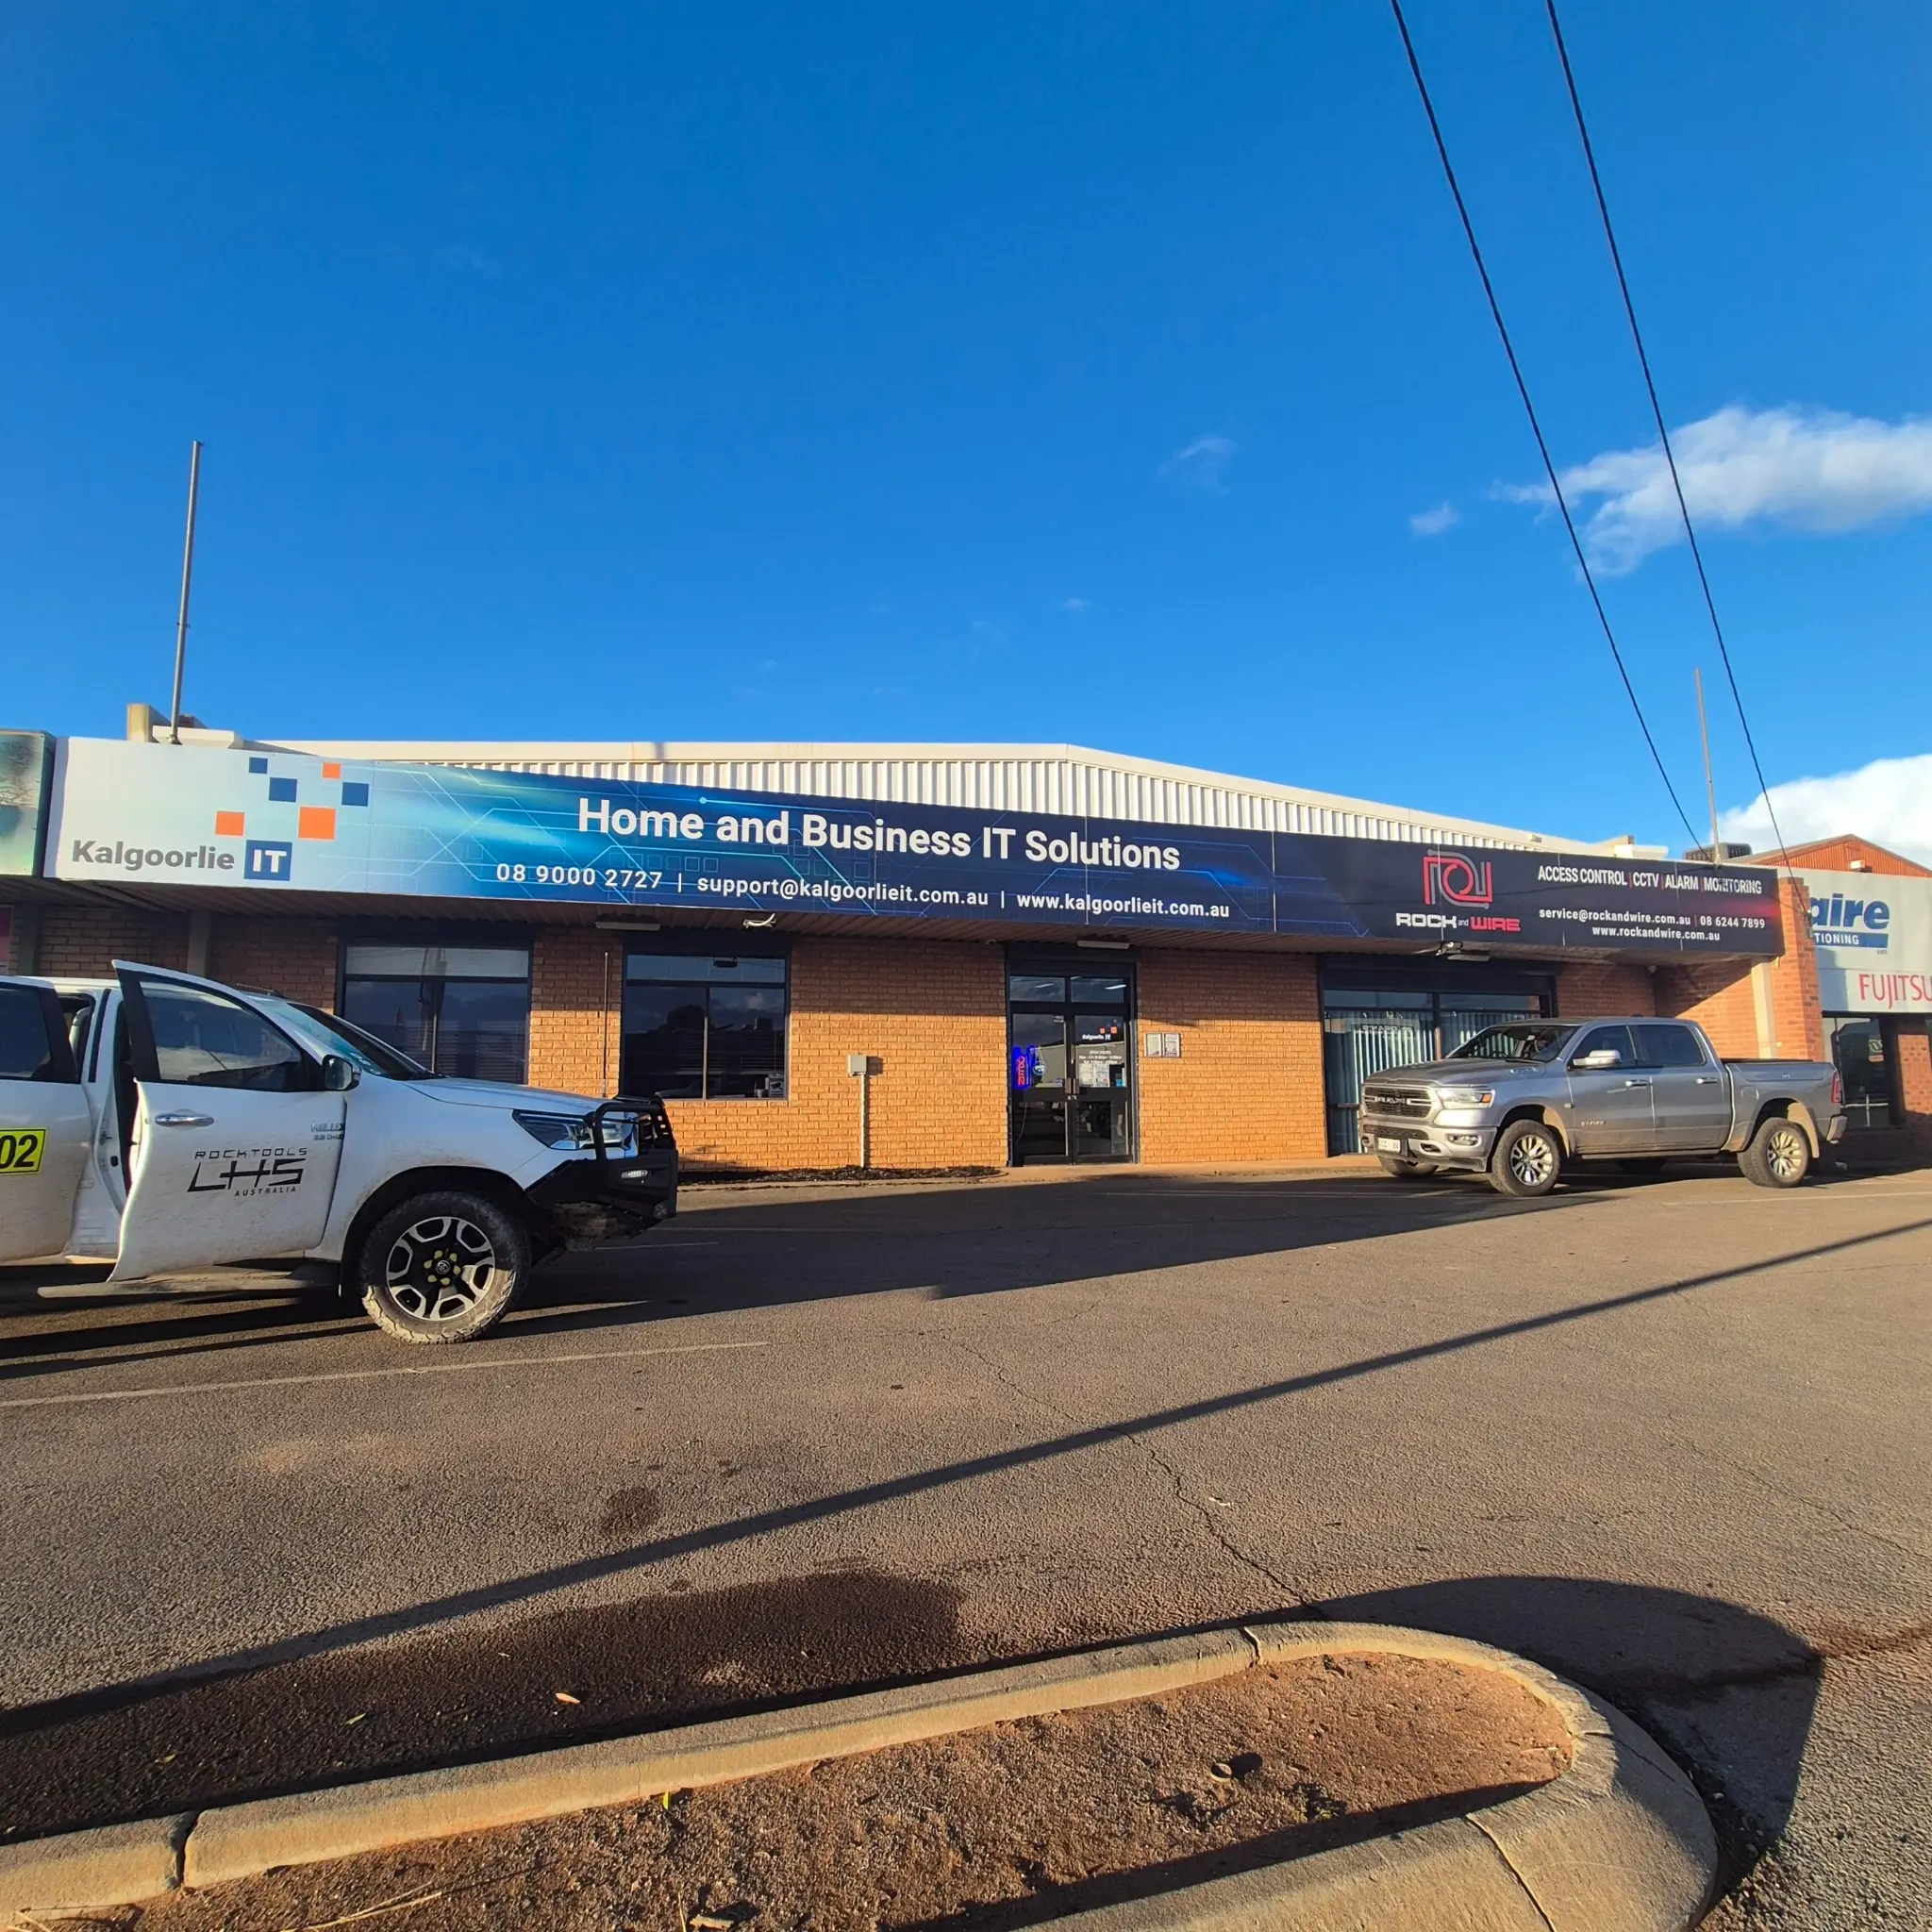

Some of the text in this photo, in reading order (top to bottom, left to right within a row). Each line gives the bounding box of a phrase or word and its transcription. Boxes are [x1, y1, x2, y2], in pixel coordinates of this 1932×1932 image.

[578, 797, 1181, 872] Home and Business IT Solutions
[72, 840, 288, 874] Kalgoorlie IT
[1538, 865, 1579, 884] ACCESS
[1580, 868, 1628, 887] CONTROL
[1633, 872, 1659, 889] CCTV
[1665, 874, 1699, 891] ALARM
[495, 862, 1230, 920] 08 9000 2727 support@kalgoorlieit.com.au www.kalgoorlieit.com.au
[1395, 911, 1521, 932] ROCK and WIRE
[1539, 907, 1766, 930] service@rockandwire.com.au 08 6244 7899
[1591, 925, 1721, 941] www.rockandwire.com.au
[194, 1147, 308, 1159] ROCKTOOLS
[234, 1186, 296, 1197] AUSTRALIA
